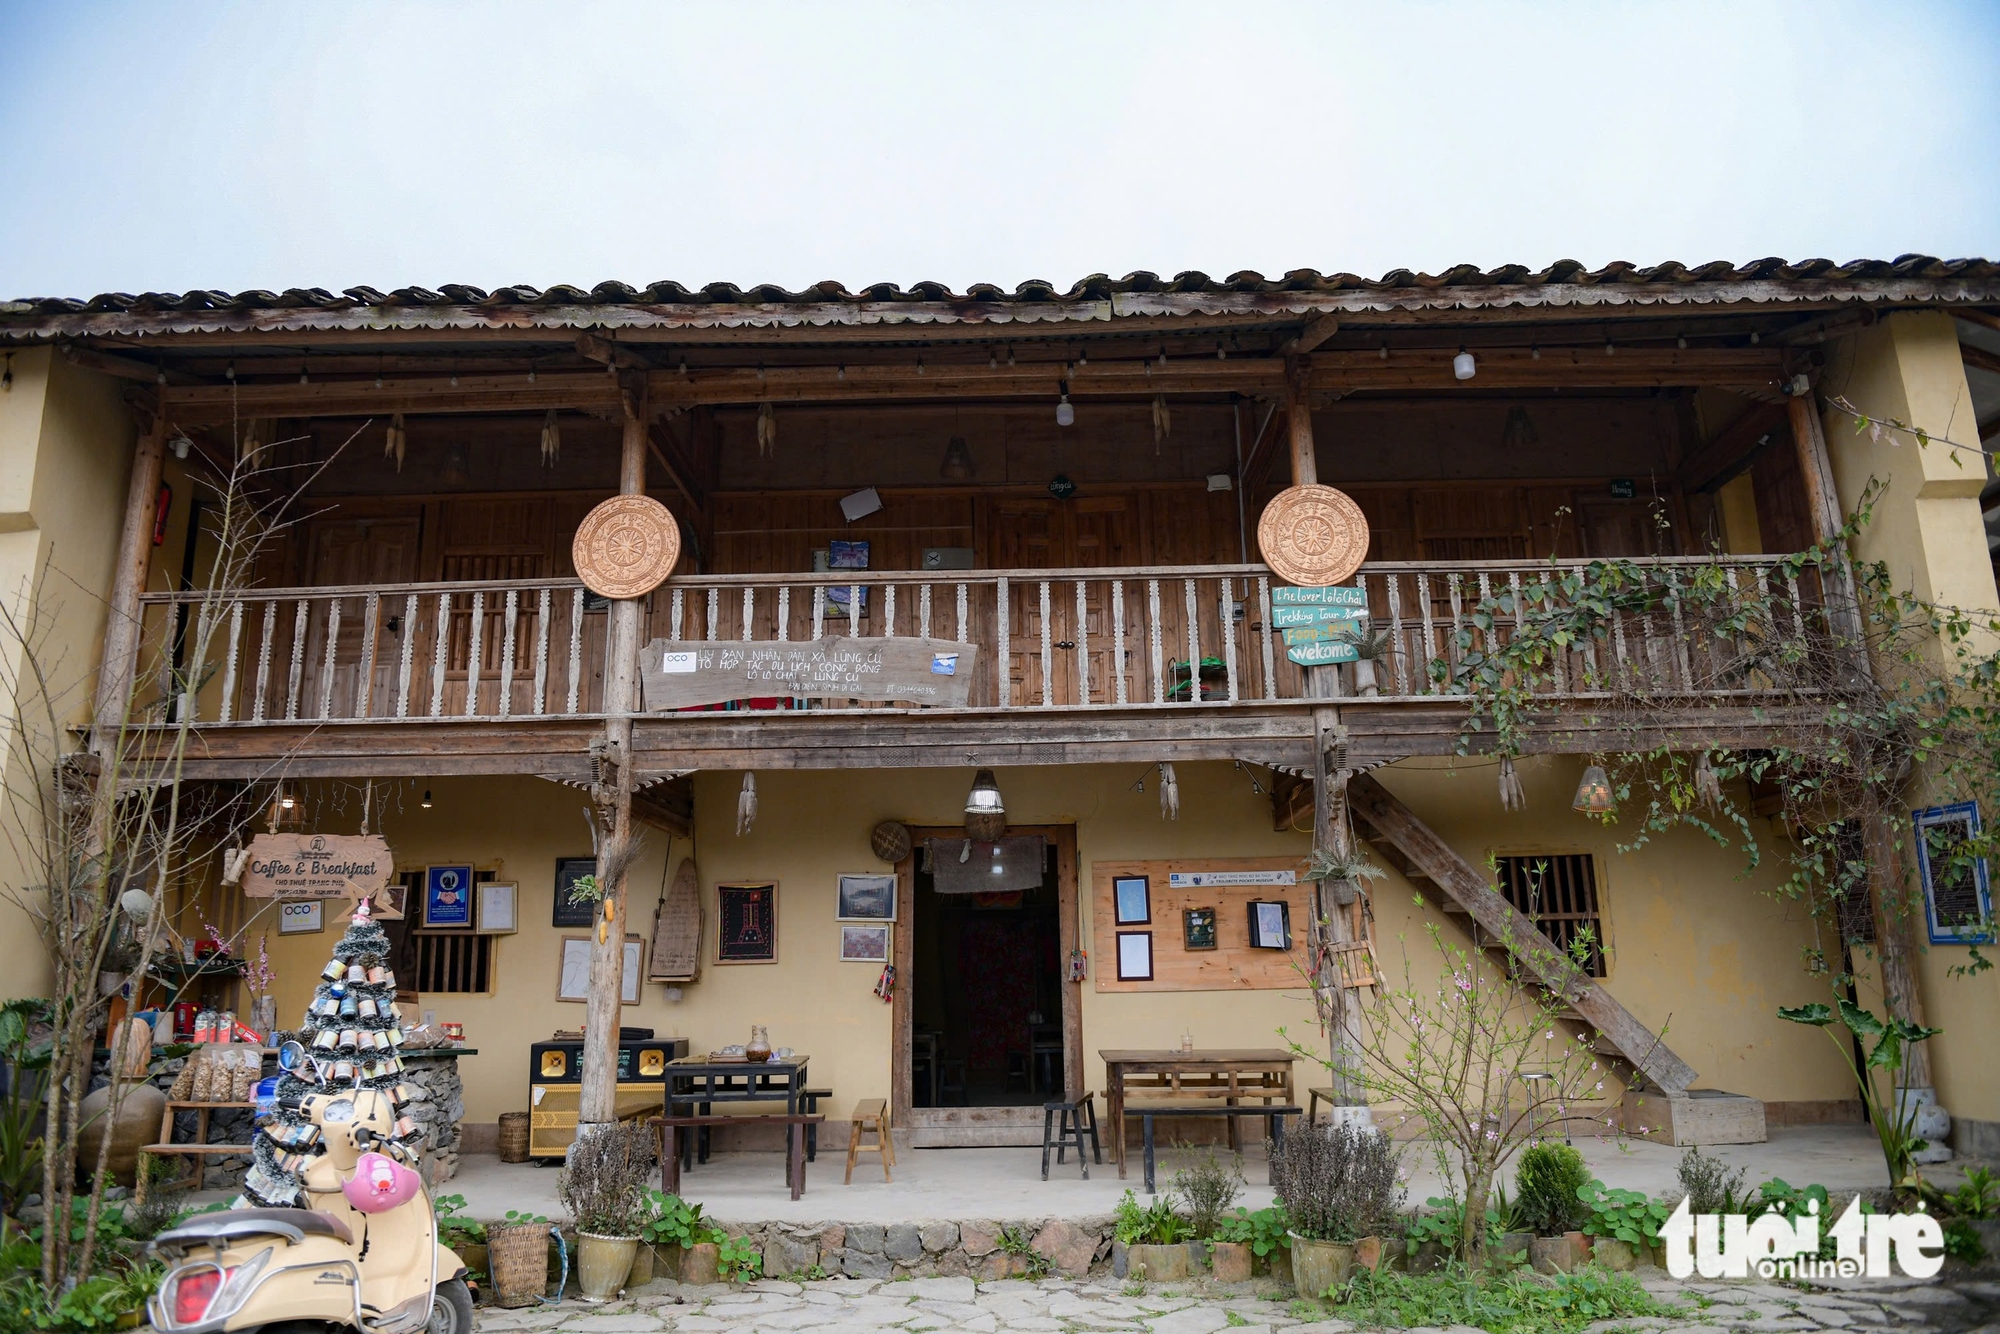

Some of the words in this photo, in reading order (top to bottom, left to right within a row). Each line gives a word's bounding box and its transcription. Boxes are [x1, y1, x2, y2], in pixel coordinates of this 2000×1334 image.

[1274, 587, 1295, 603] The
[1274, 608, 1313, 625] Trekking
[1318, 607, 1340, 620] Tour
[721, 649, 745, 661] BAN
[752, 648, 781, 661] NHÂN
[787, 649, 805, 661] DÂN
[834, 649, 862, 663] LŨNG
[867, 649, 883, 664] CÚ
[1289, 642, 1354, 660] welcome
[771, 661, 784, 671] DU
[251, 860, 292, 879] Coffee
[295, 862, 306, 876] &
[311, 861, 377, 879] Breakfast
[284, 904, 318, 916] OCOP
